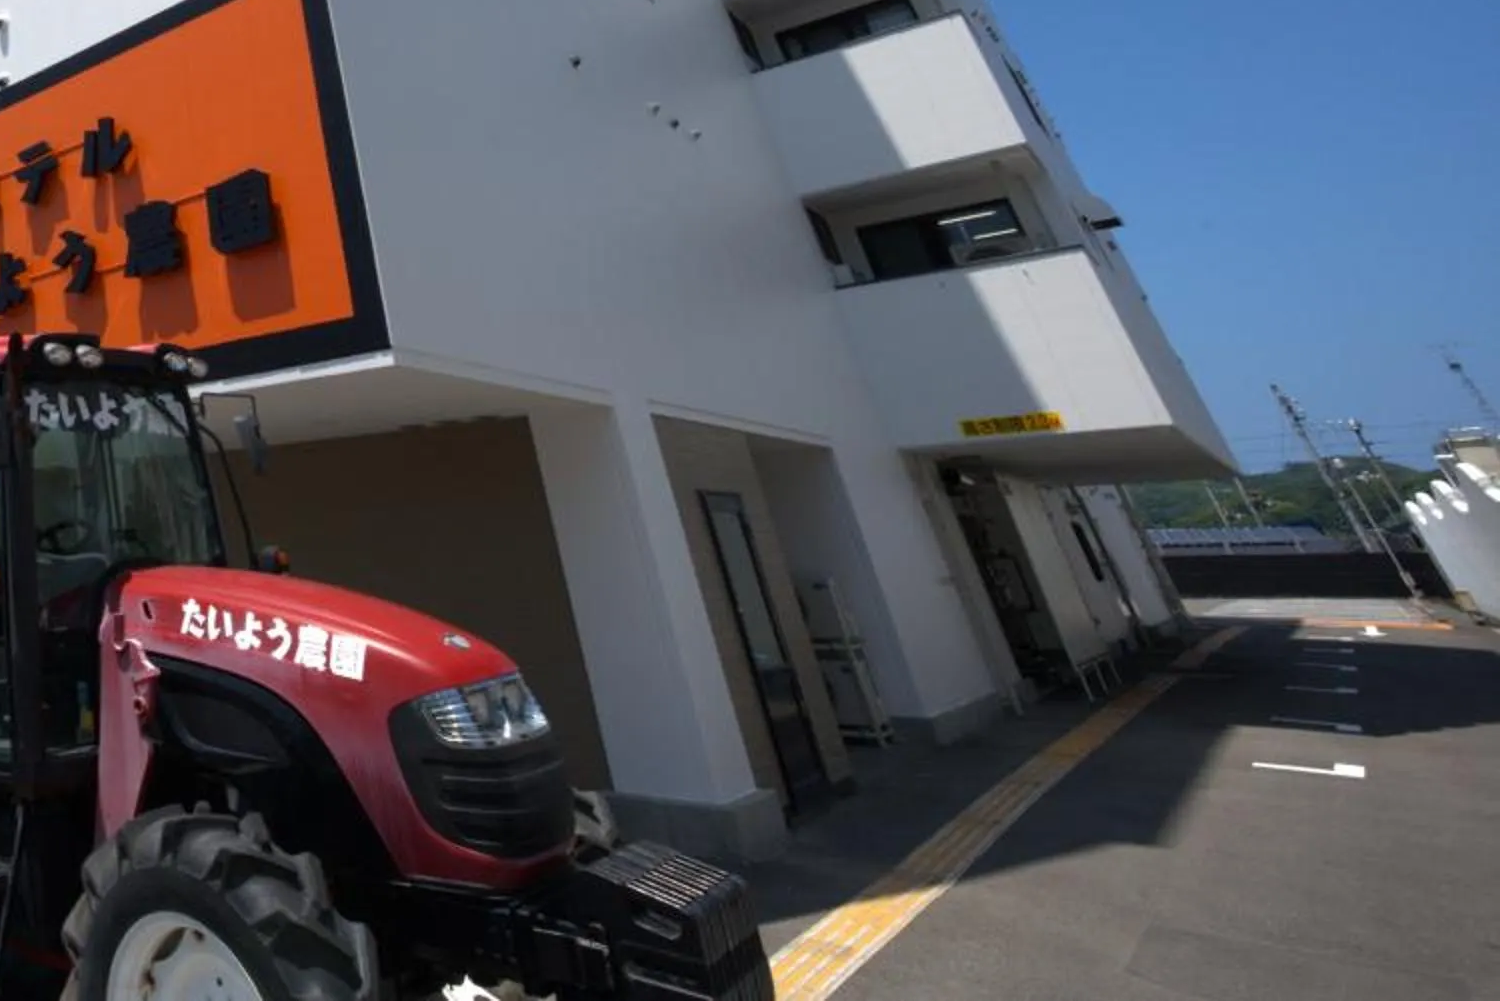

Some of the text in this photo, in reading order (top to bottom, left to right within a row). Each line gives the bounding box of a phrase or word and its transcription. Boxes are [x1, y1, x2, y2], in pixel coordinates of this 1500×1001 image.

[180, 598, 367, 682] たいよう農園
